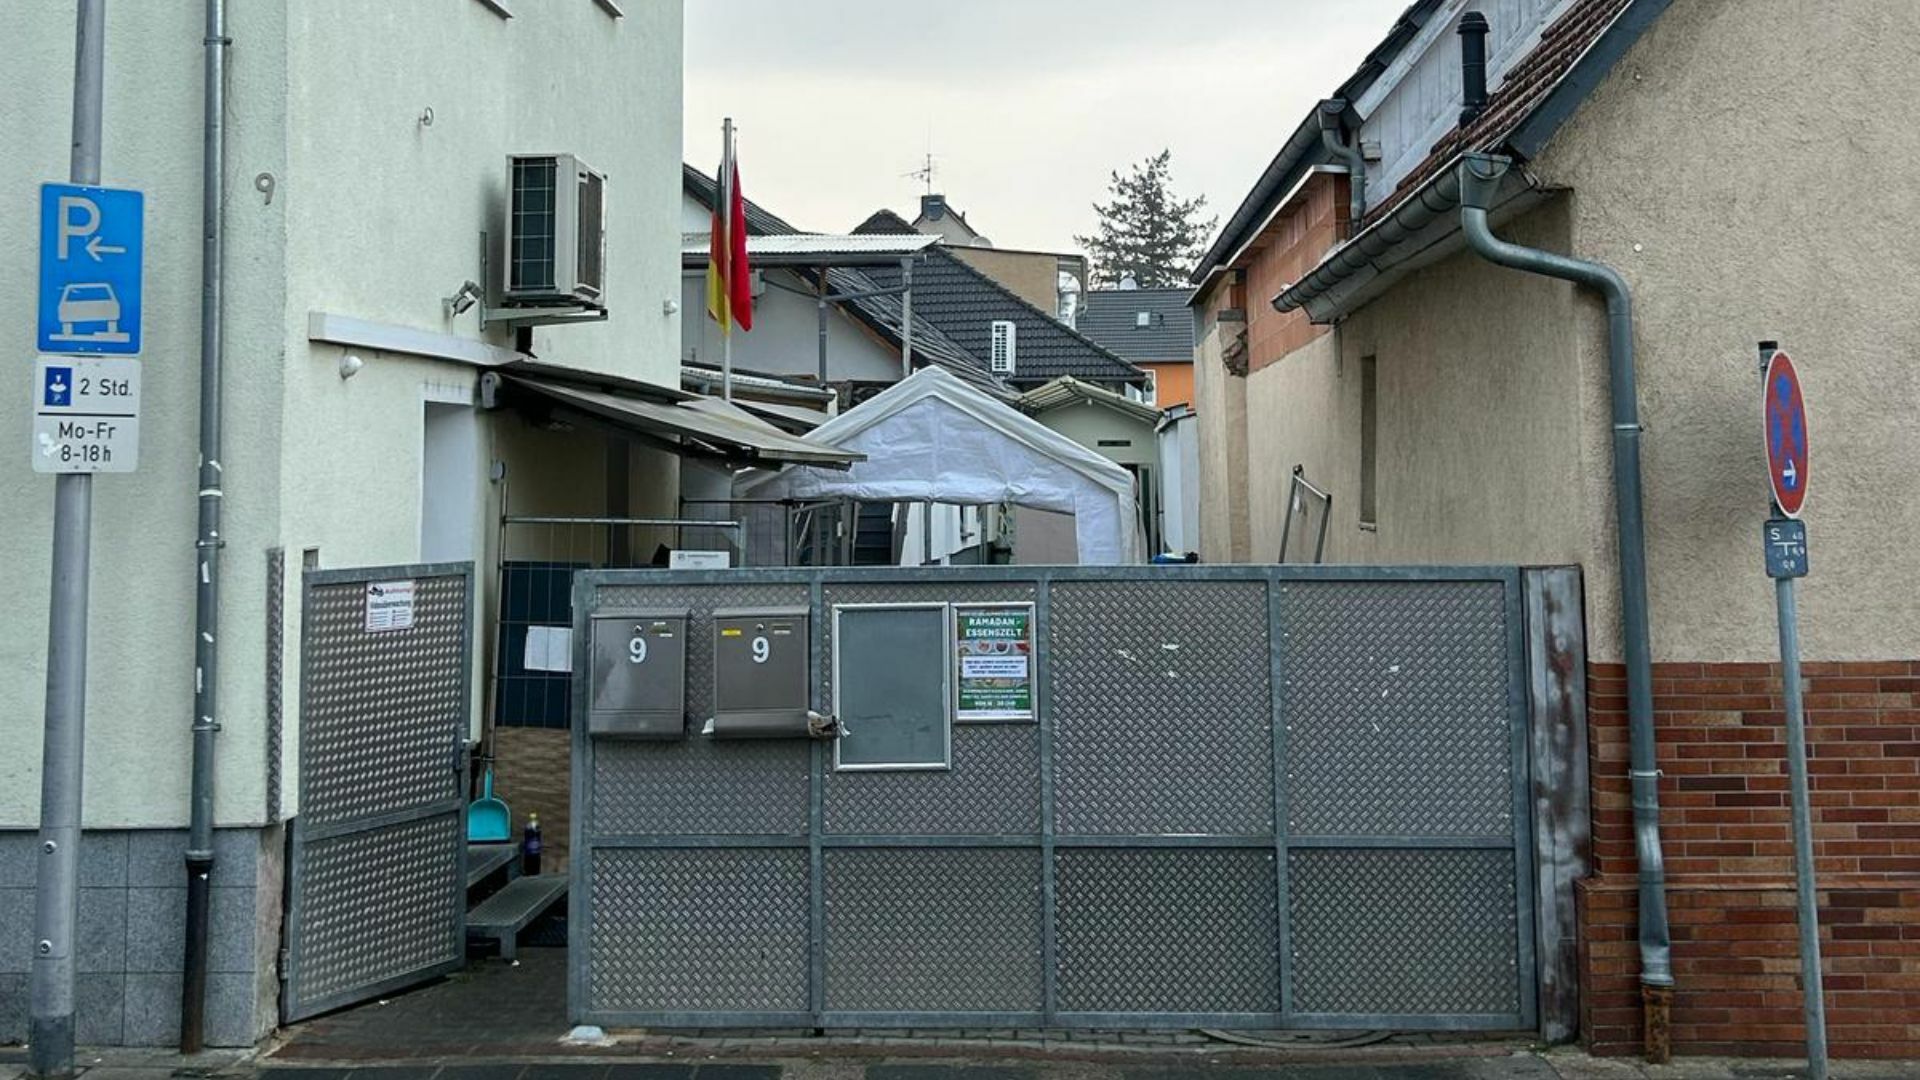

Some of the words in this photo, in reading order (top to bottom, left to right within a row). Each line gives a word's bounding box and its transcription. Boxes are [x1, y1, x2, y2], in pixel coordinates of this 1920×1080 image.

[256, 172, 275, 205] 9
[58, 196, 100, 259] P
[79, 378, 90, 396] 2
[99, 378, 133, 397] Std.
[59, 421, 116, 440] Mo-Fr
[1770, 527, 1781, 541] S
[965, 628, 1023, 638] ESSENSZELT
[629, 636, 647, 664] 9
[752, 636, 770, 664] 9
